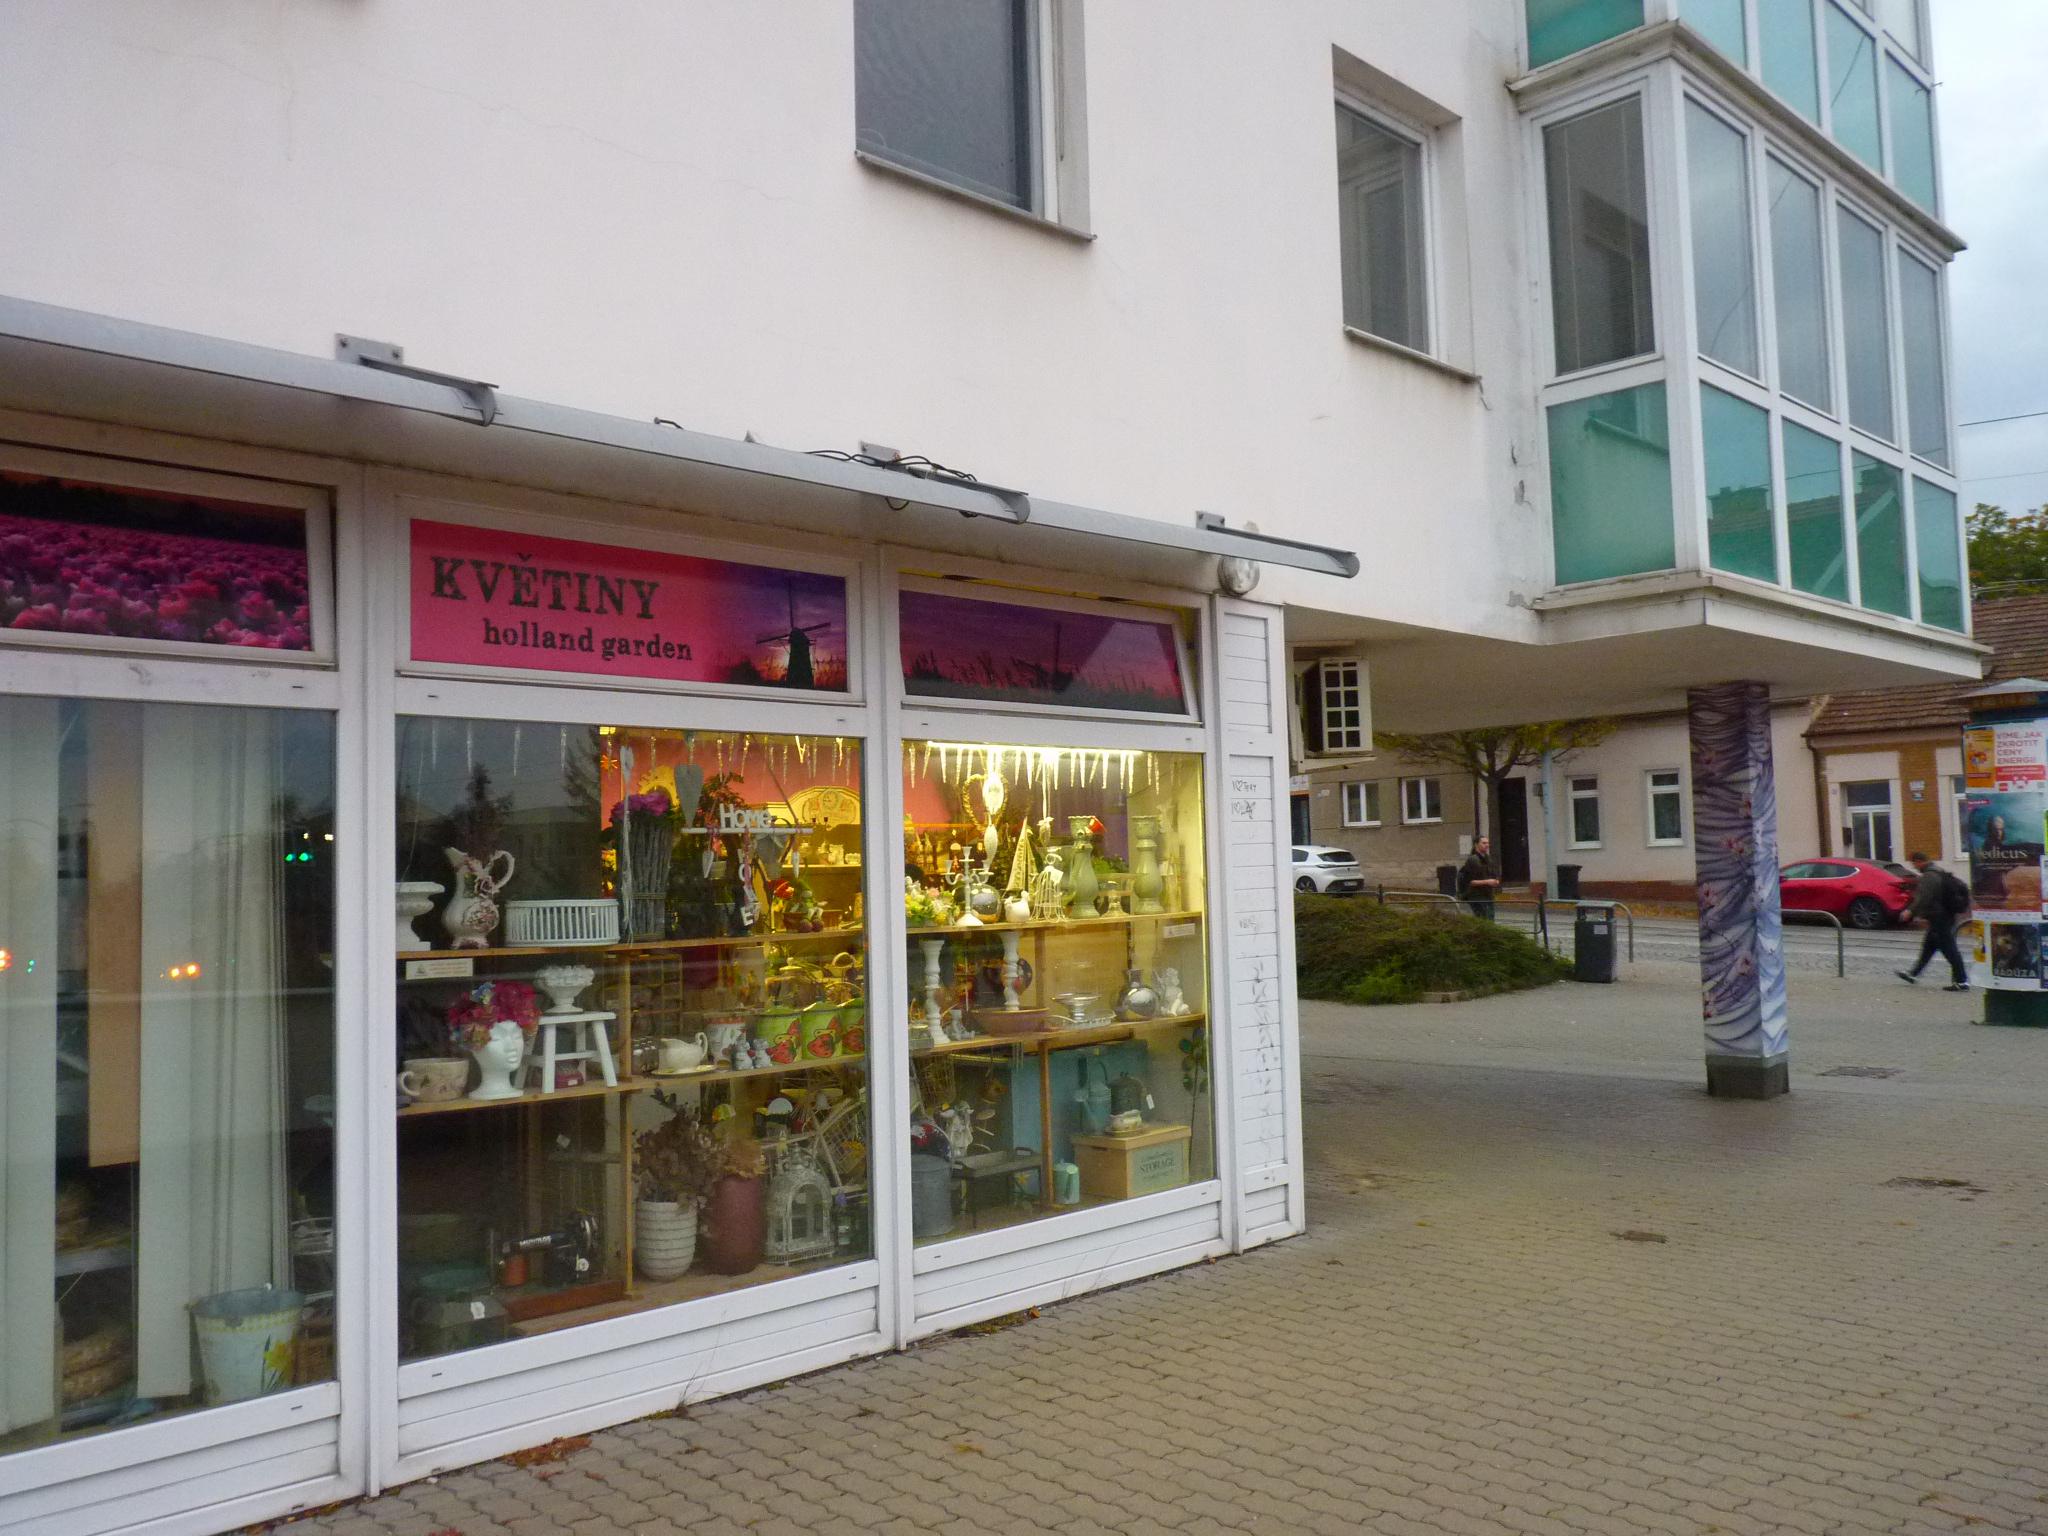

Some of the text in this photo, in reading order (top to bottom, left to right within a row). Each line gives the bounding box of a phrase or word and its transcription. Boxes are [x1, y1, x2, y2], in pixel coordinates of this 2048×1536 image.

[431, 552, 660, 620] KVĚTINY
[482, 617, 693, 661] holland garden
